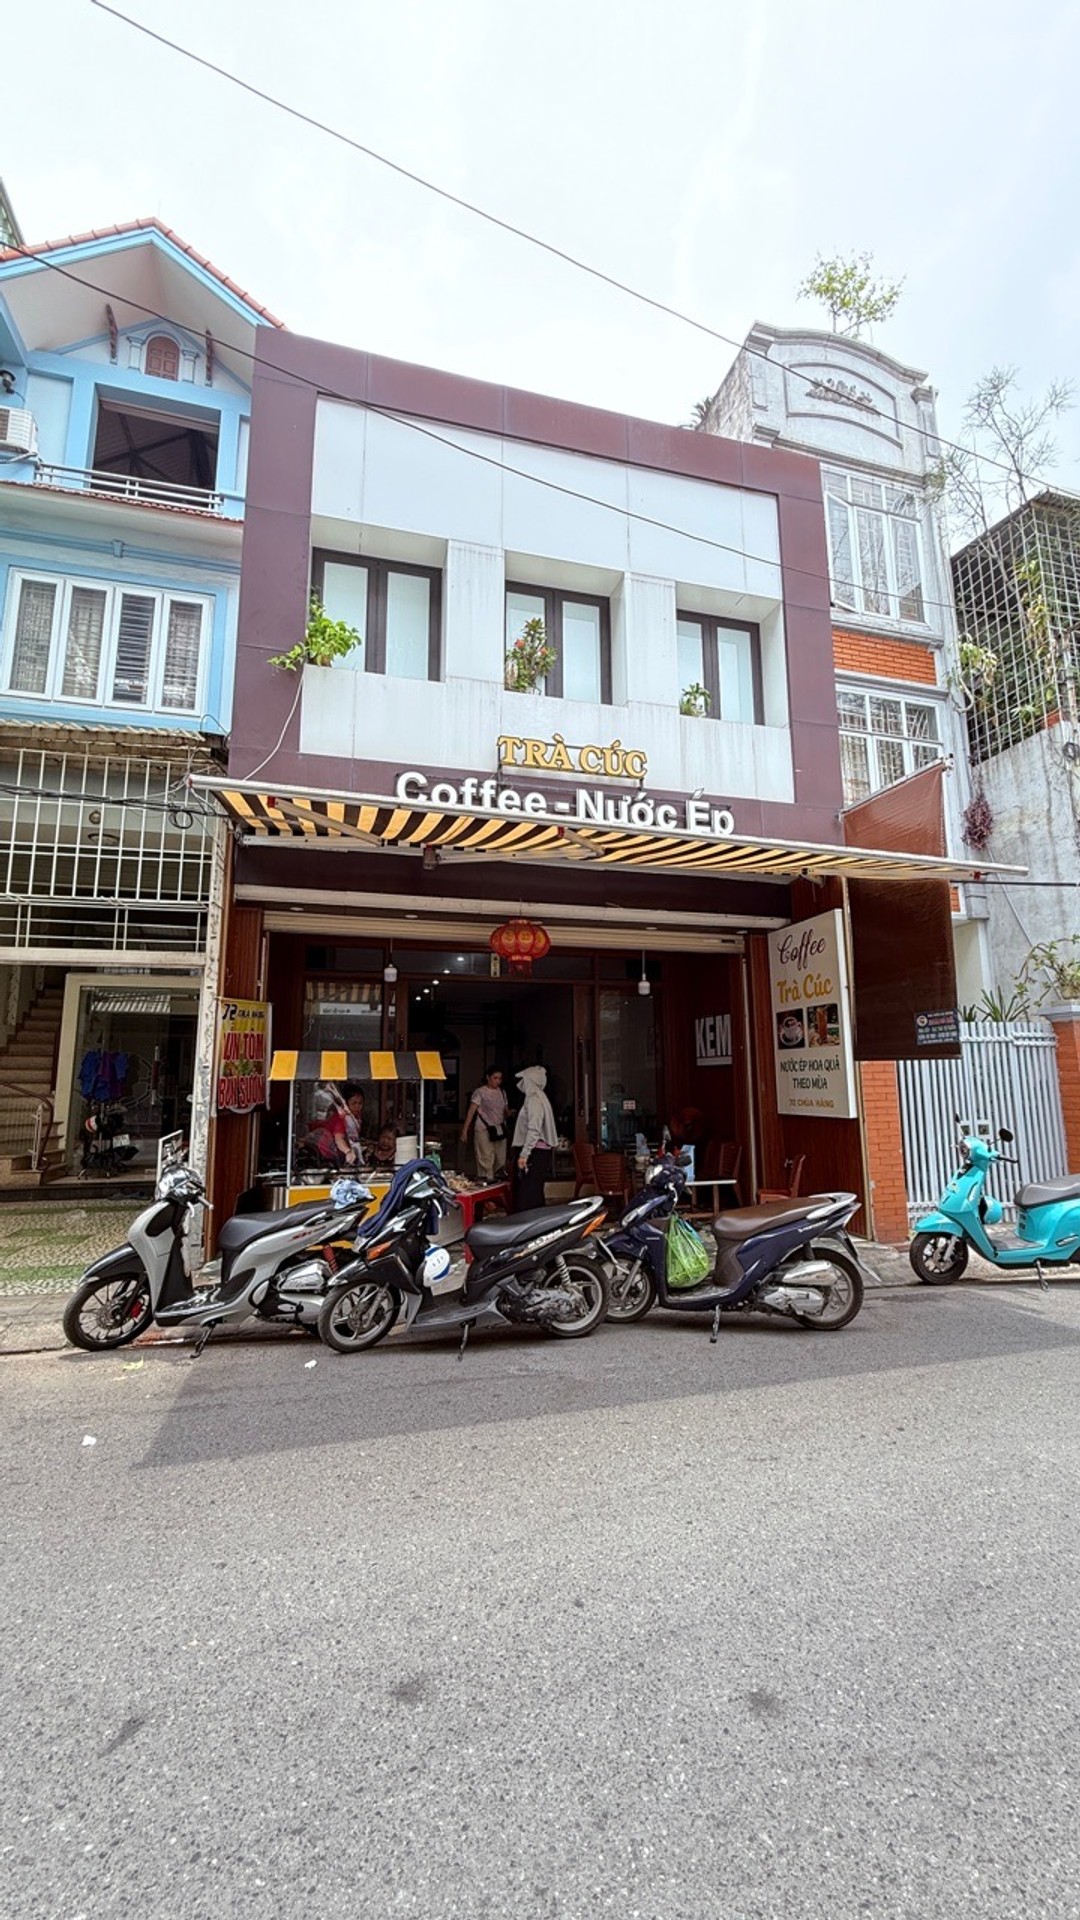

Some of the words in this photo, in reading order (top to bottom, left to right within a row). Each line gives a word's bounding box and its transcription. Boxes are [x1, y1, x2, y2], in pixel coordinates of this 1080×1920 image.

[498, 733, 575, 771] TRÀ
[579, 740, 648, 778] CÚC
[396, 771, 547, 815] Coffee
[576, 788, 678, 830] Nước
[686, 788, 736, 836] Ép
[777, 929, 826, 971] Coffee
[777, 979, 801, 1003] Trà
[803, 973, 833, 998] Cúc
[222, 1003, 238, 1020] 72
[695, 1014, 731, 1057] KEM
[792, 1077, 810, 1089] THEO
[808, 1059, 823, 1072] HOA
